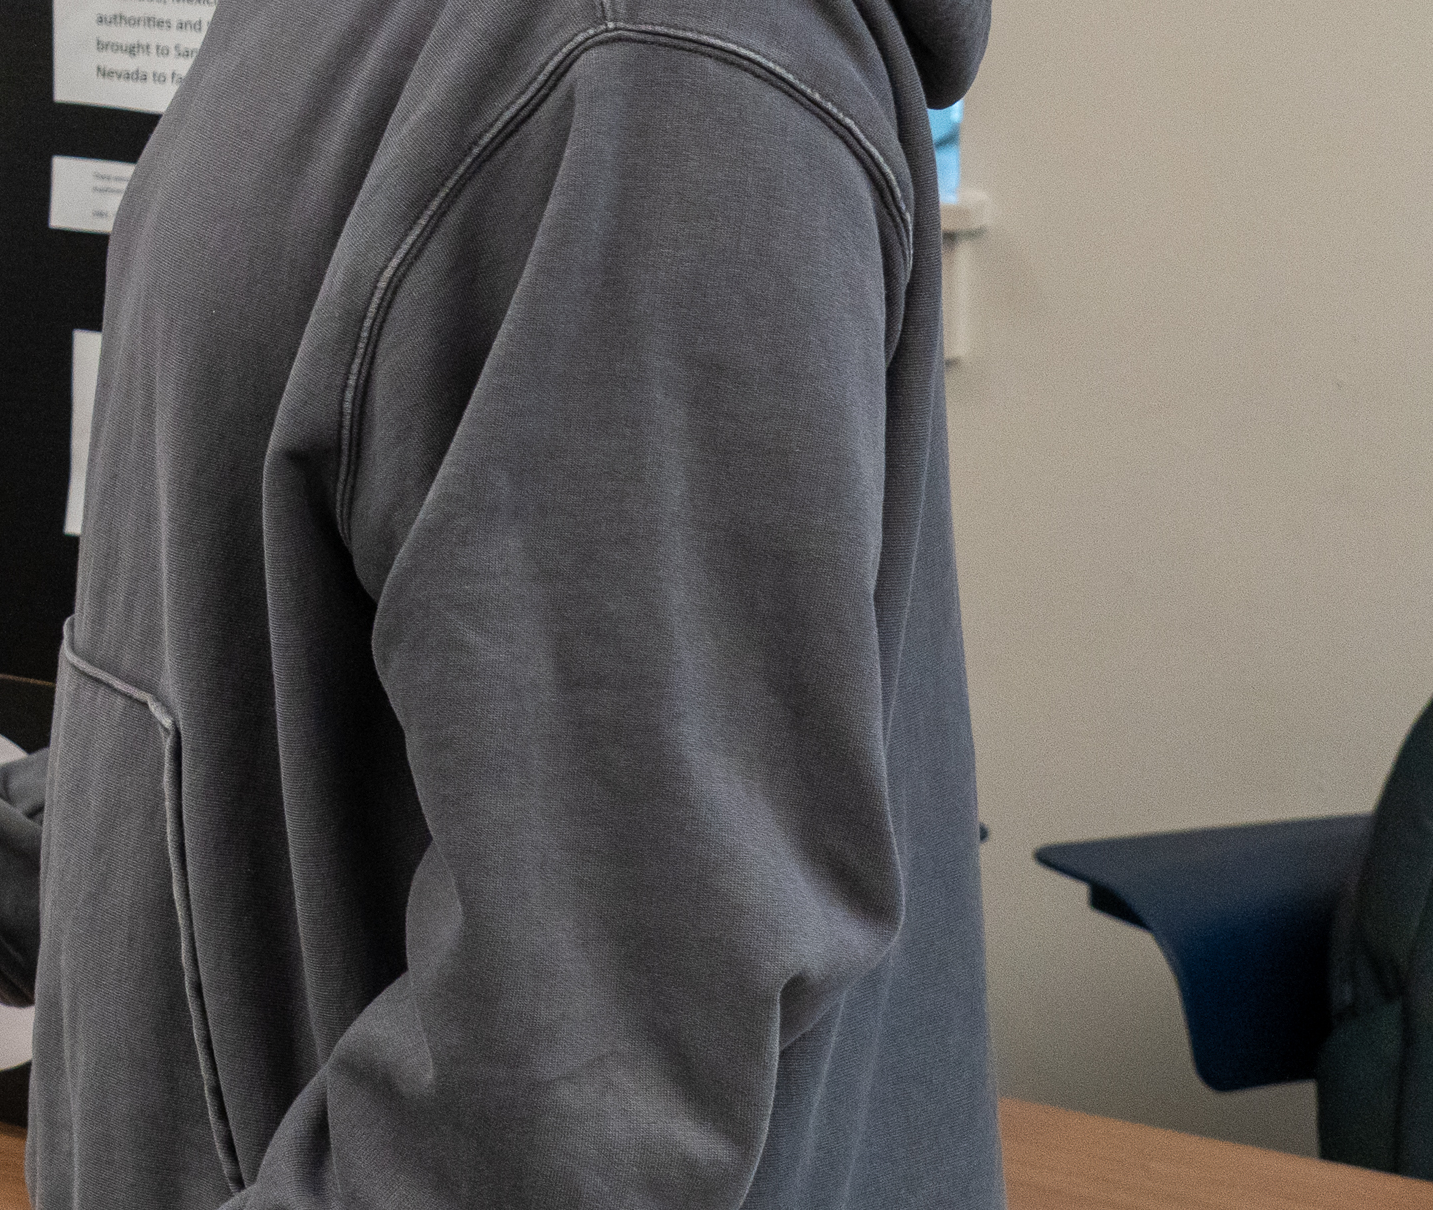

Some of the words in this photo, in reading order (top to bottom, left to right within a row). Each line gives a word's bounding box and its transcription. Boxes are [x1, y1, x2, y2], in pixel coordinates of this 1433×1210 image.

[96, 12, 172, 30] authorities
[176, 19, 202, 33] and
[96, 36, 151, 58] brought
[155, 44, 170, 57] to
[96, 65, 148, 83] Nevada
[152, 71, 167, 84] to
